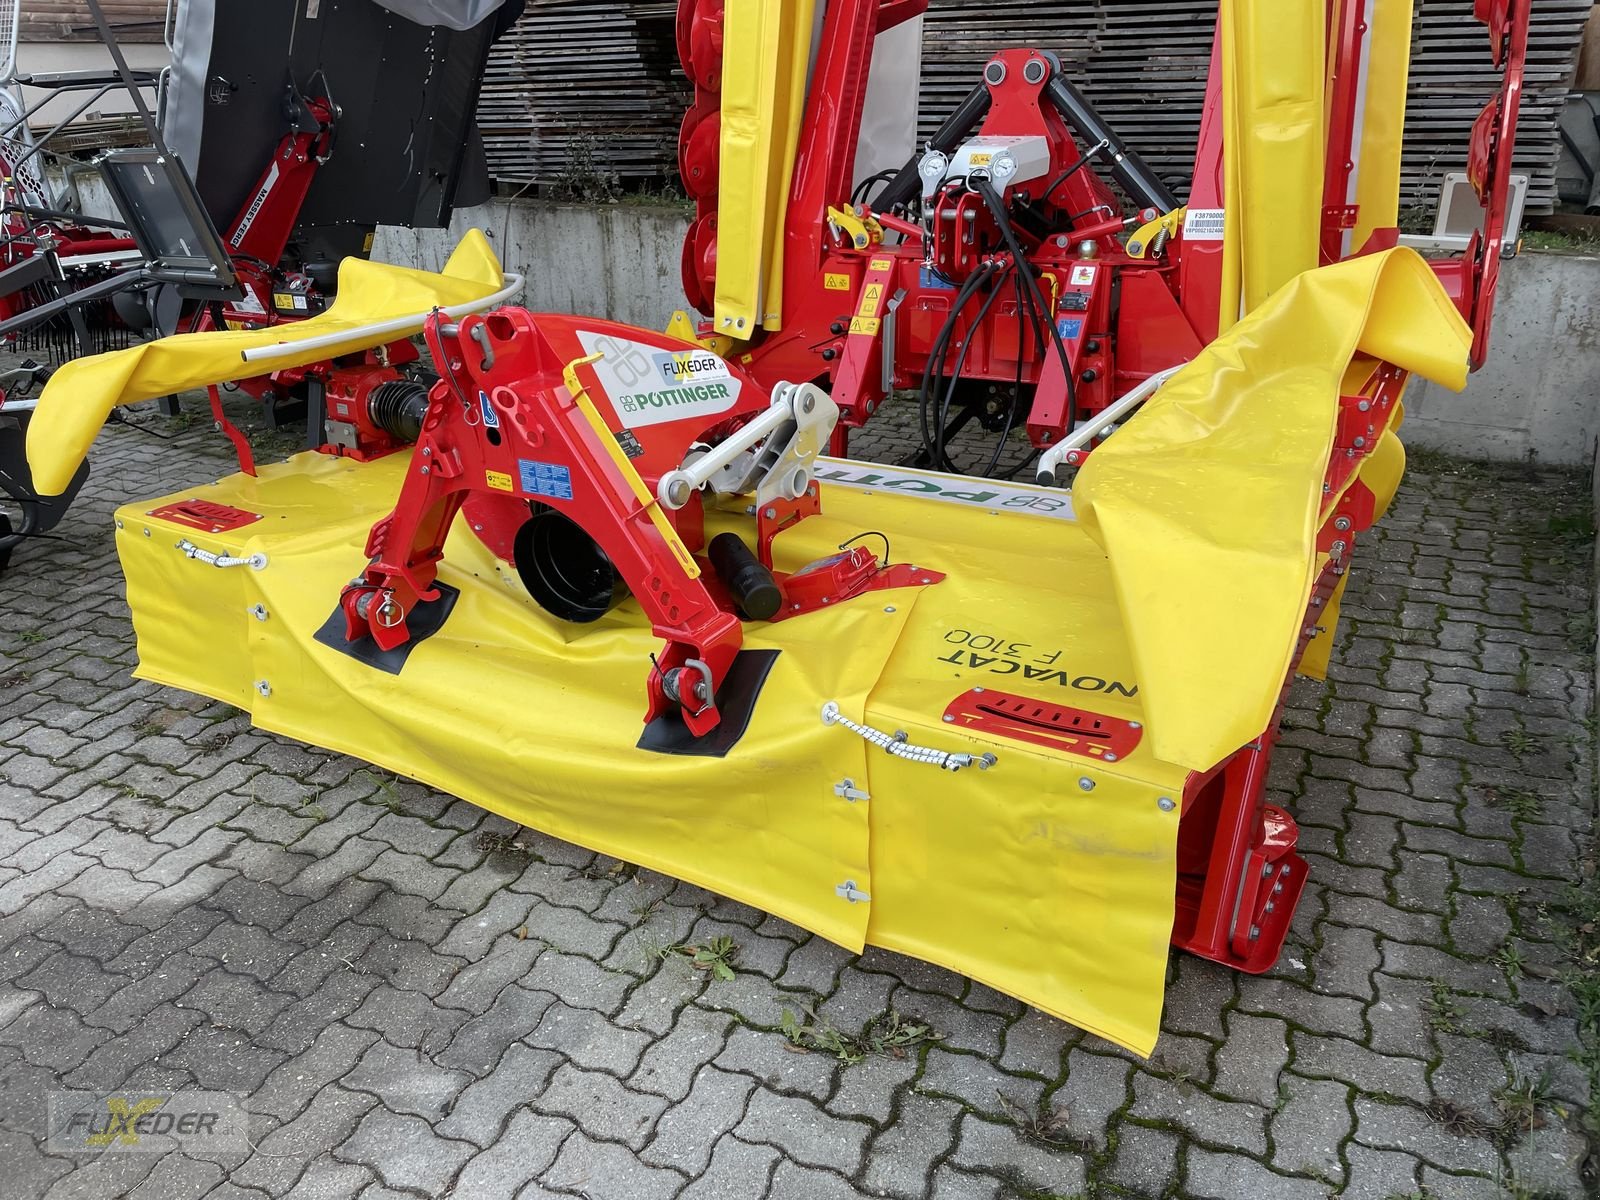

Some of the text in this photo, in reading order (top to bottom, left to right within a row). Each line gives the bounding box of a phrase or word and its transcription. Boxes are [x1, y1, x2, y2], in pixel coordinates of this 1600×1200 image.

[232, 188, 268, 245] MASSEY FERG
[634, 383, 730, 410] PÖTTINGER
[943, 629, 1063, 665] F 3100
[937, 650, 1139, 697] NOVACAT
